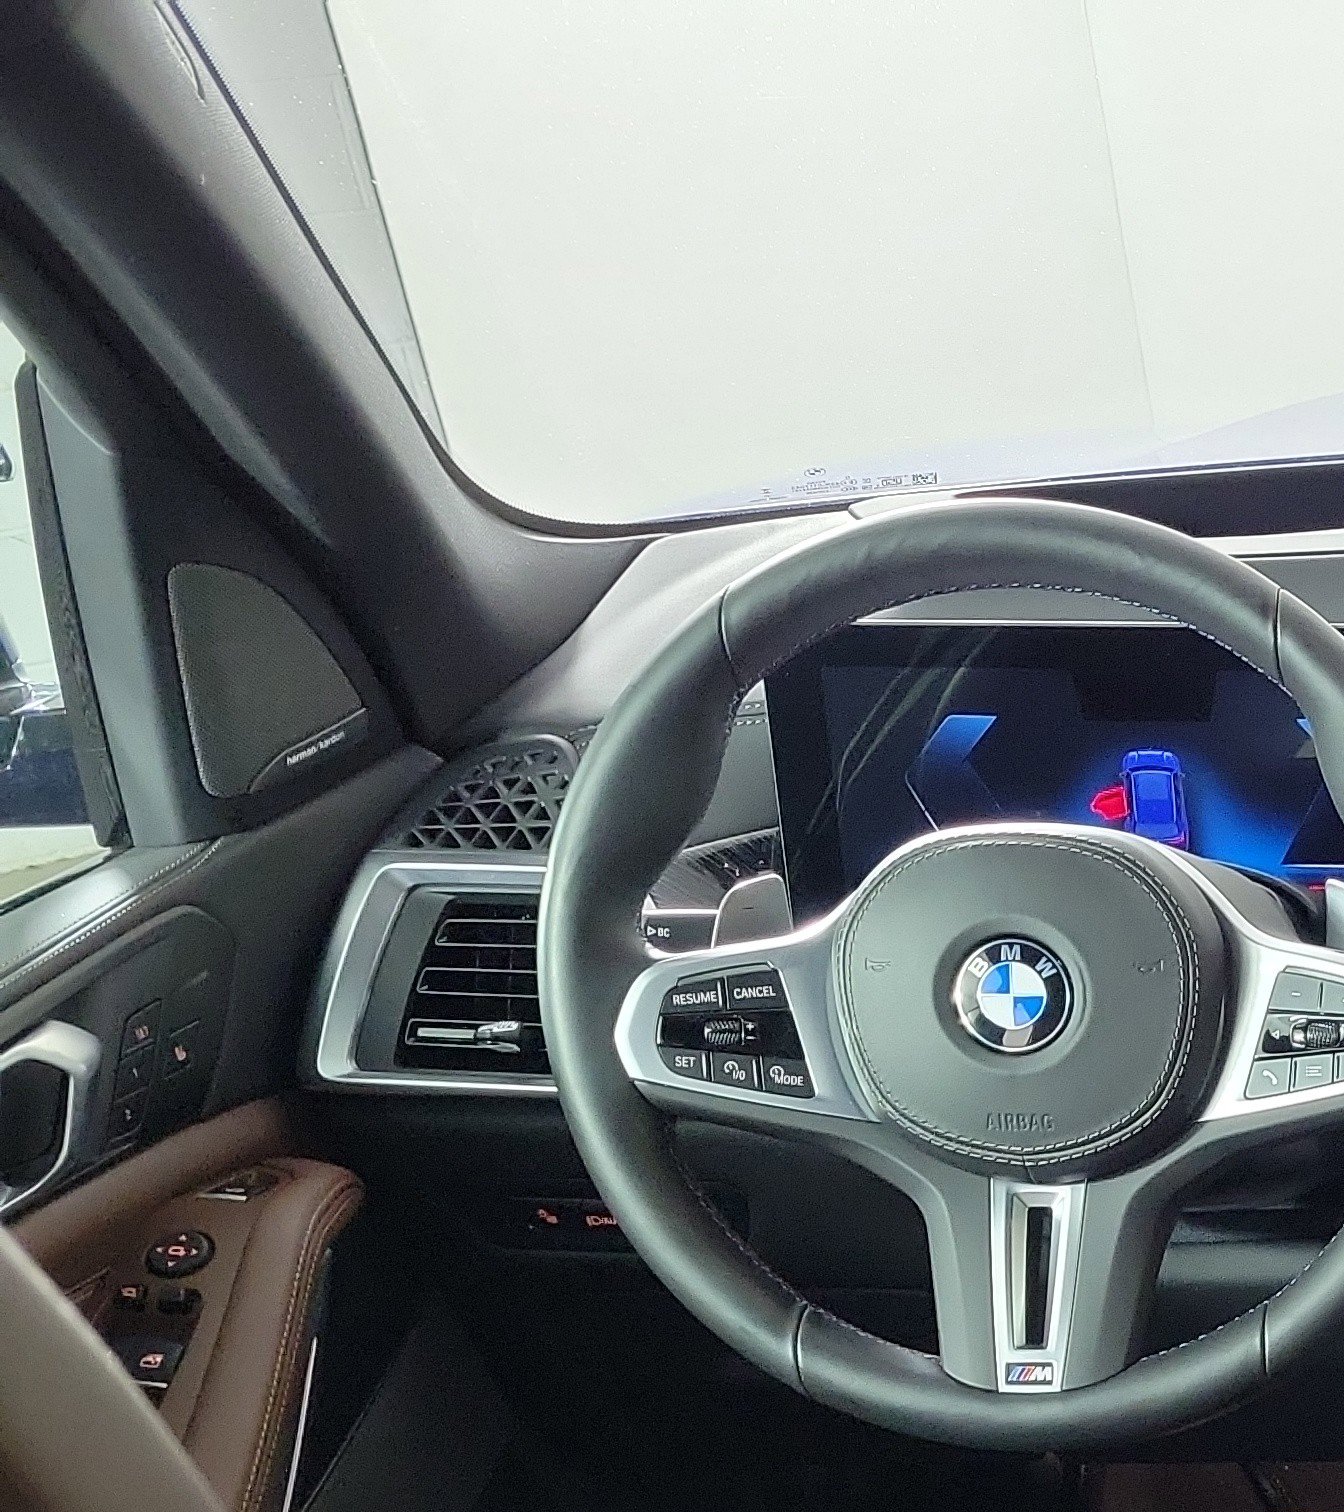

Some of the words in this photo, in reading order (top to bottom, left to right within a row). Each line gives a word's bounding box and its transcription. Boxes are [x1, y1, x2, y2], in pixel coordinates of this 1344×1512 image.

[967, 944, 1059, 979] BMW
[672, 990, 718, 1006] RESUME
[733, 985, 777, 1000] CANCEL
[674, 1056, 696, 1068] SET
[774, 1075, 804, 1087] MODE
[986, 1112, 1055, 1133] AIRBAG
